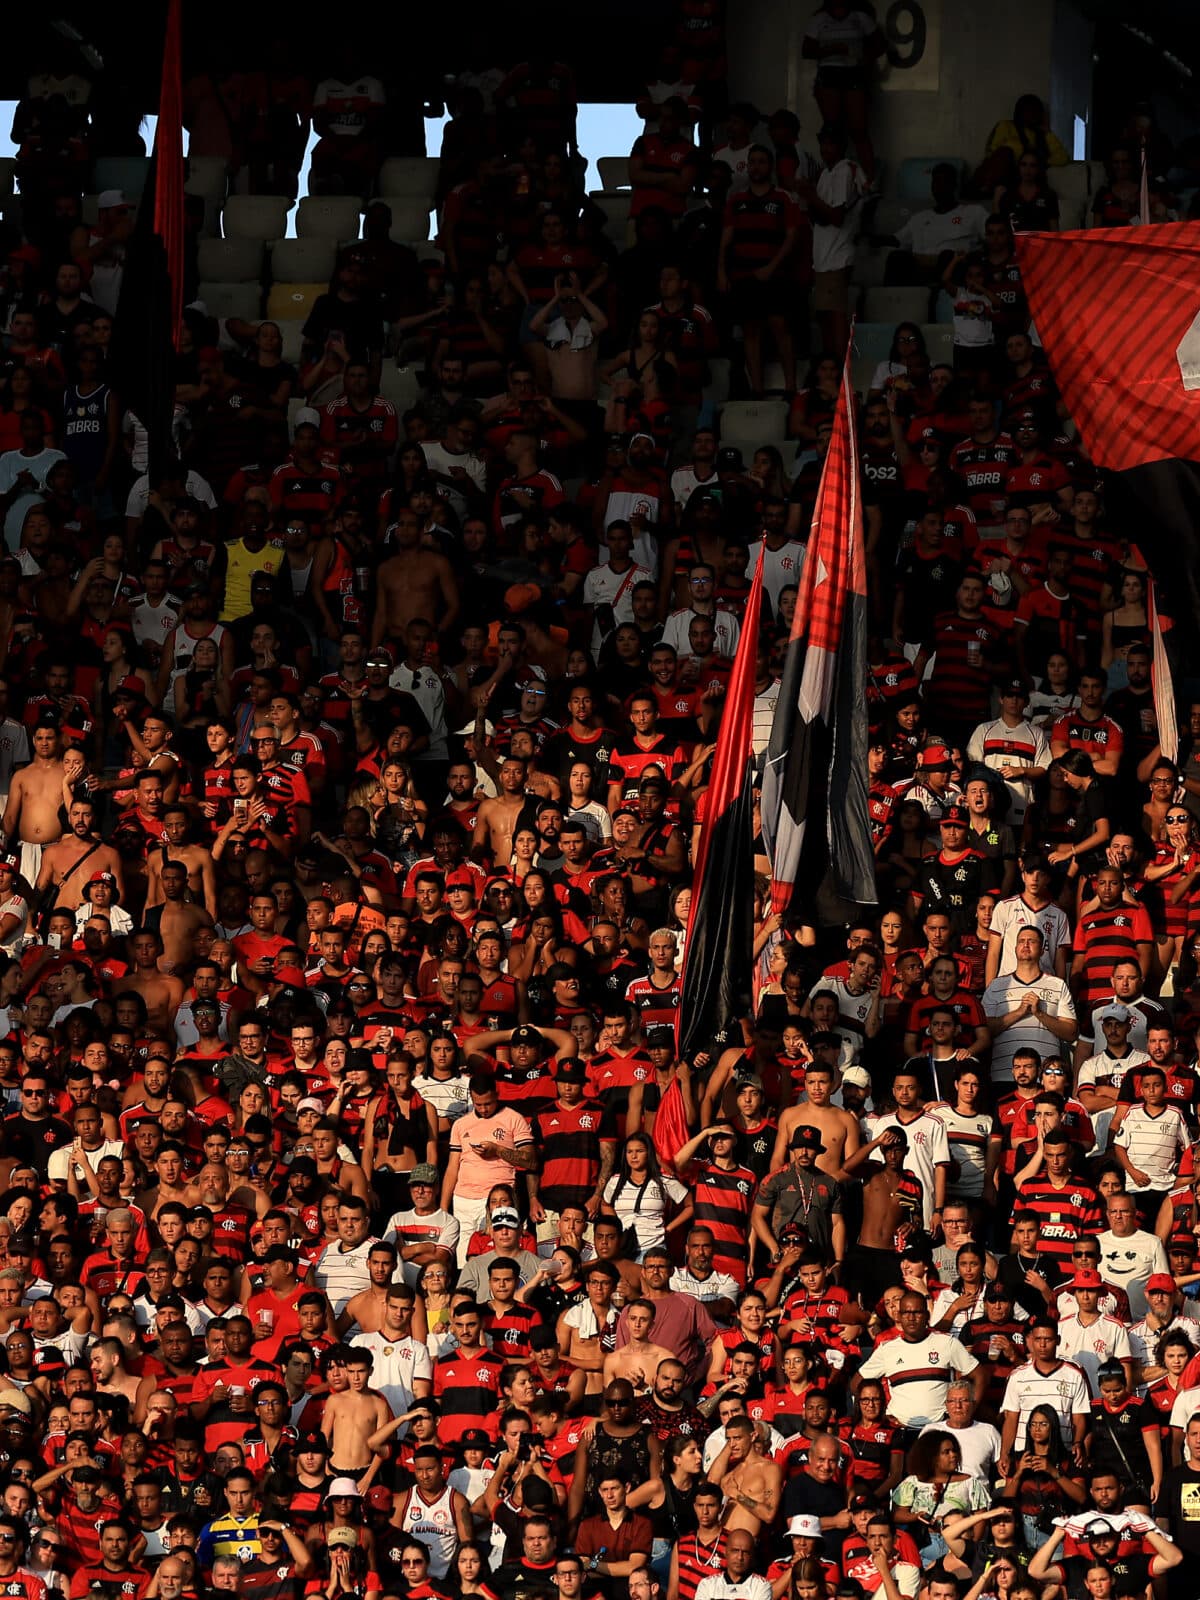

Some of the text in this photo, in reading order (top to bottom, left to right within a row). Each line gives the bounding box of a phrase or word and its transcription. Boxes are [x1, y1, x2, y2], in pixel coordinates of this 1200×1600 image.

[76, 419, 100, 434] BRB
[865, 463, 896, 481] bs2
[976, 472, 1001, 485] BRB
